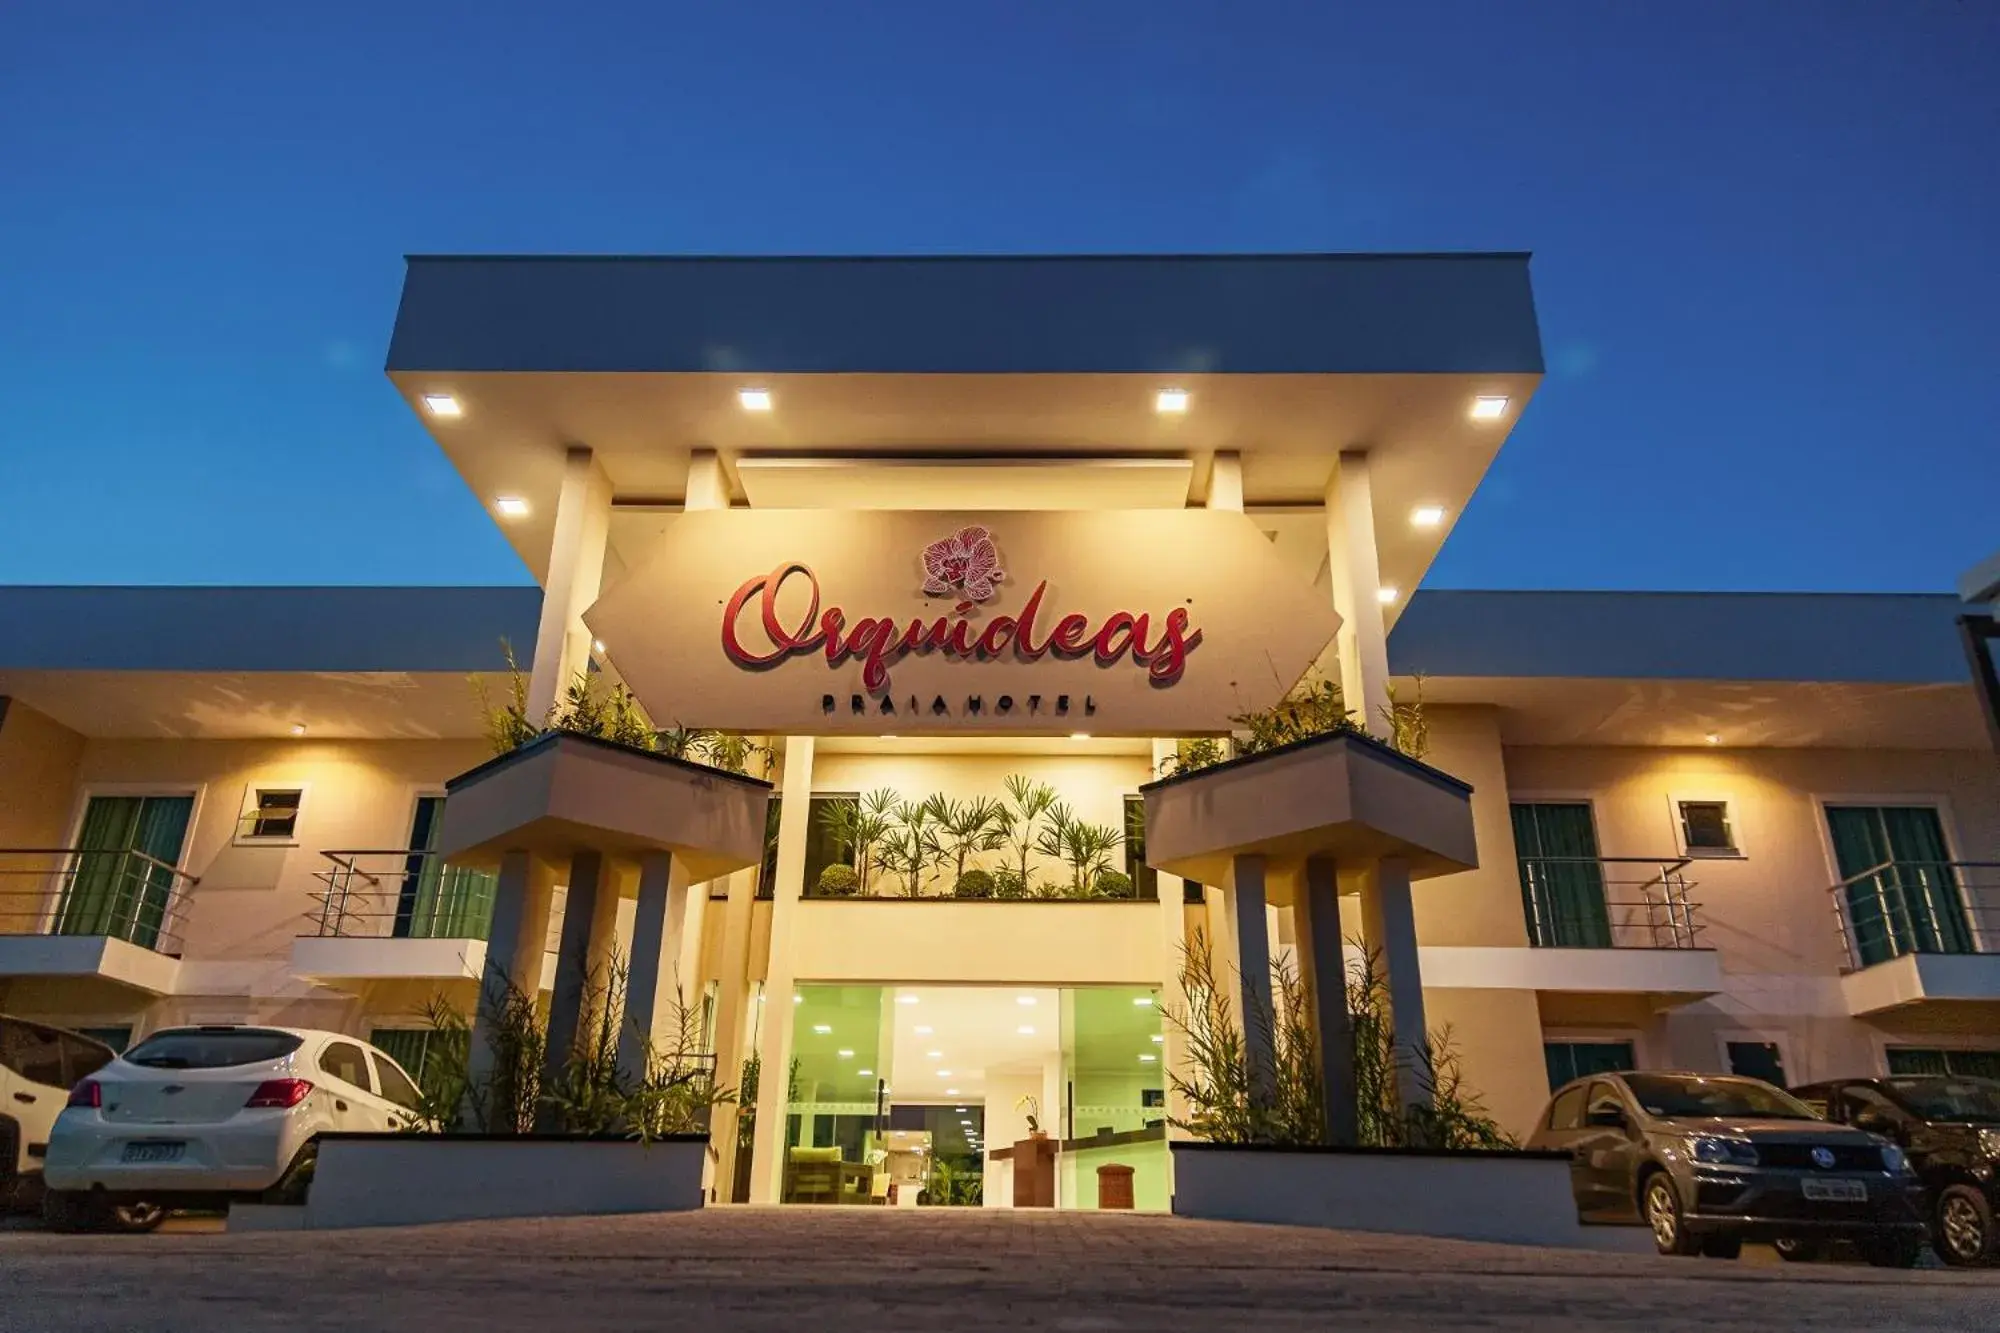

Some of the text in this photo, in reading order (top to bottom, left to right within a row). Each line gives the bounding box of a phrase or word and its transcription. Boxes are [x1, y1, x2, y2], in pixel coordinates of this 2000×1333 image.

[722, 561, 1203, 692] Orquídeas
[822, 694, 1096, 716] PRAIA HOTEL
